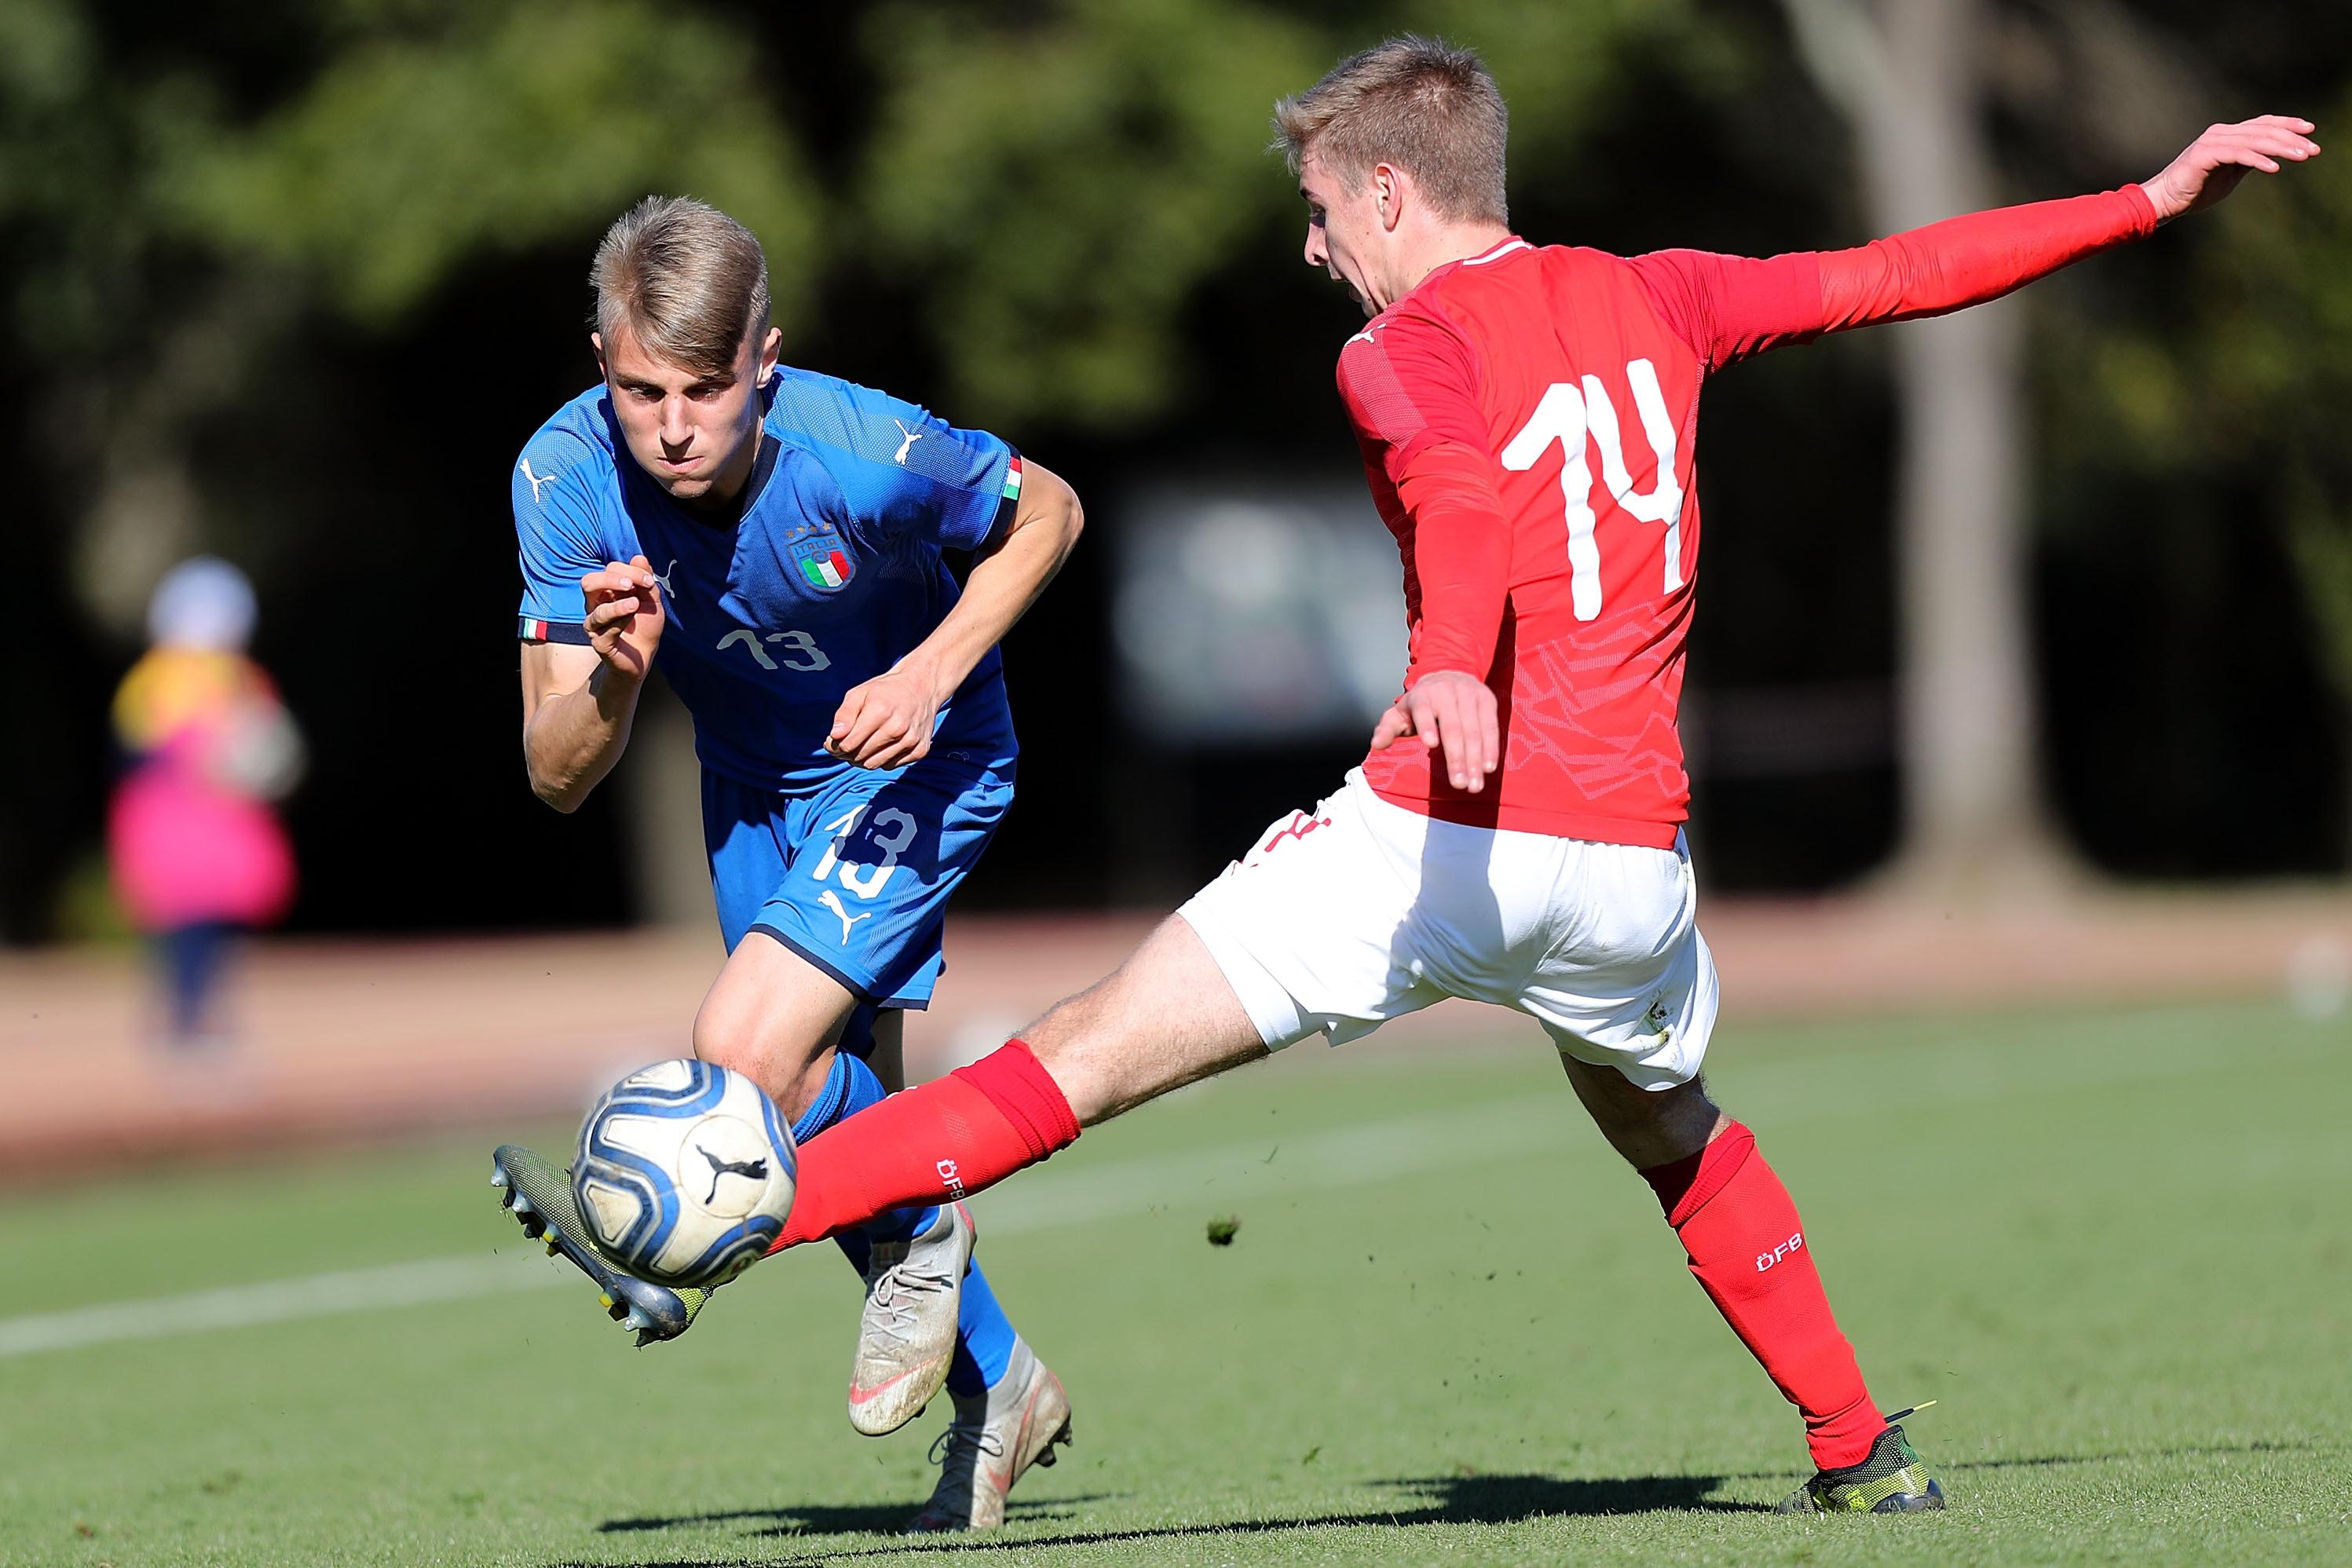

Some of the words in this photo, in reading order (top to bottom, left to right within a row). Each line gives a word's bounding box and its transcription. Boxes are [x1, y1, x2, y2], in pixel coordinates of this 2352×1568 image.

[1500, 357, 1684, 622] 14
[794, 538, 836, 556] ITALIA
[716, 629, 832, 671] 13
[812, 804, 917, 899] 13
[936, 1159, 965, 1200] ÖFB
[1755, 1232, 1802, 1272] ÖFB
